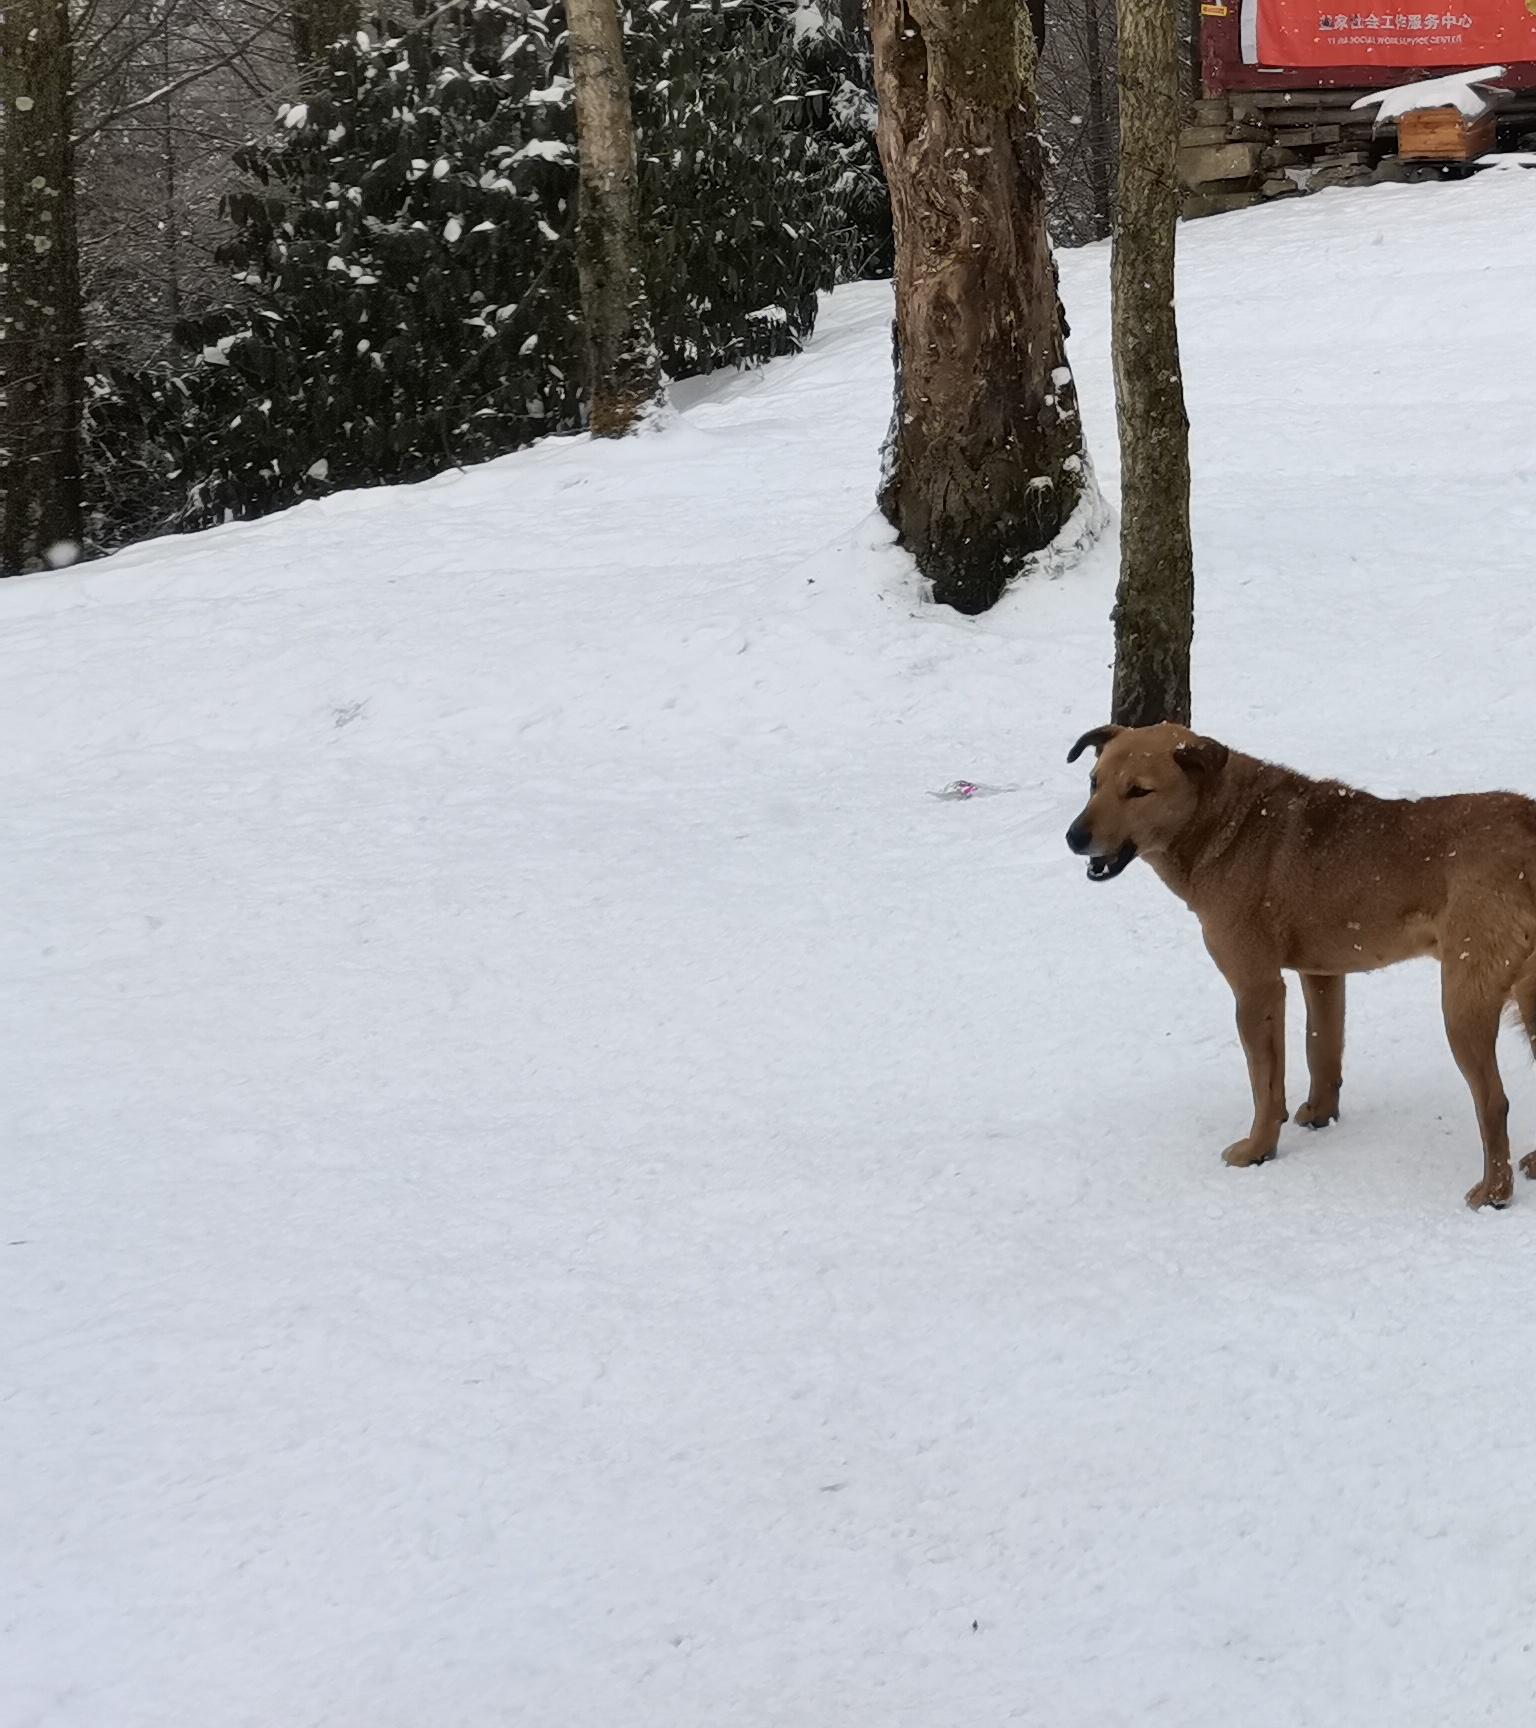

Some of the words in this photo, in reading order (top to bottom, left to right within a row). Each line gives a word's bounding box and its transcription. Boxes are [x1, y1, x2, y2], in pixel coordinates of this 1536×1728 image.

[1318, 11, 1473, 32] 益家社会工作服务中心
